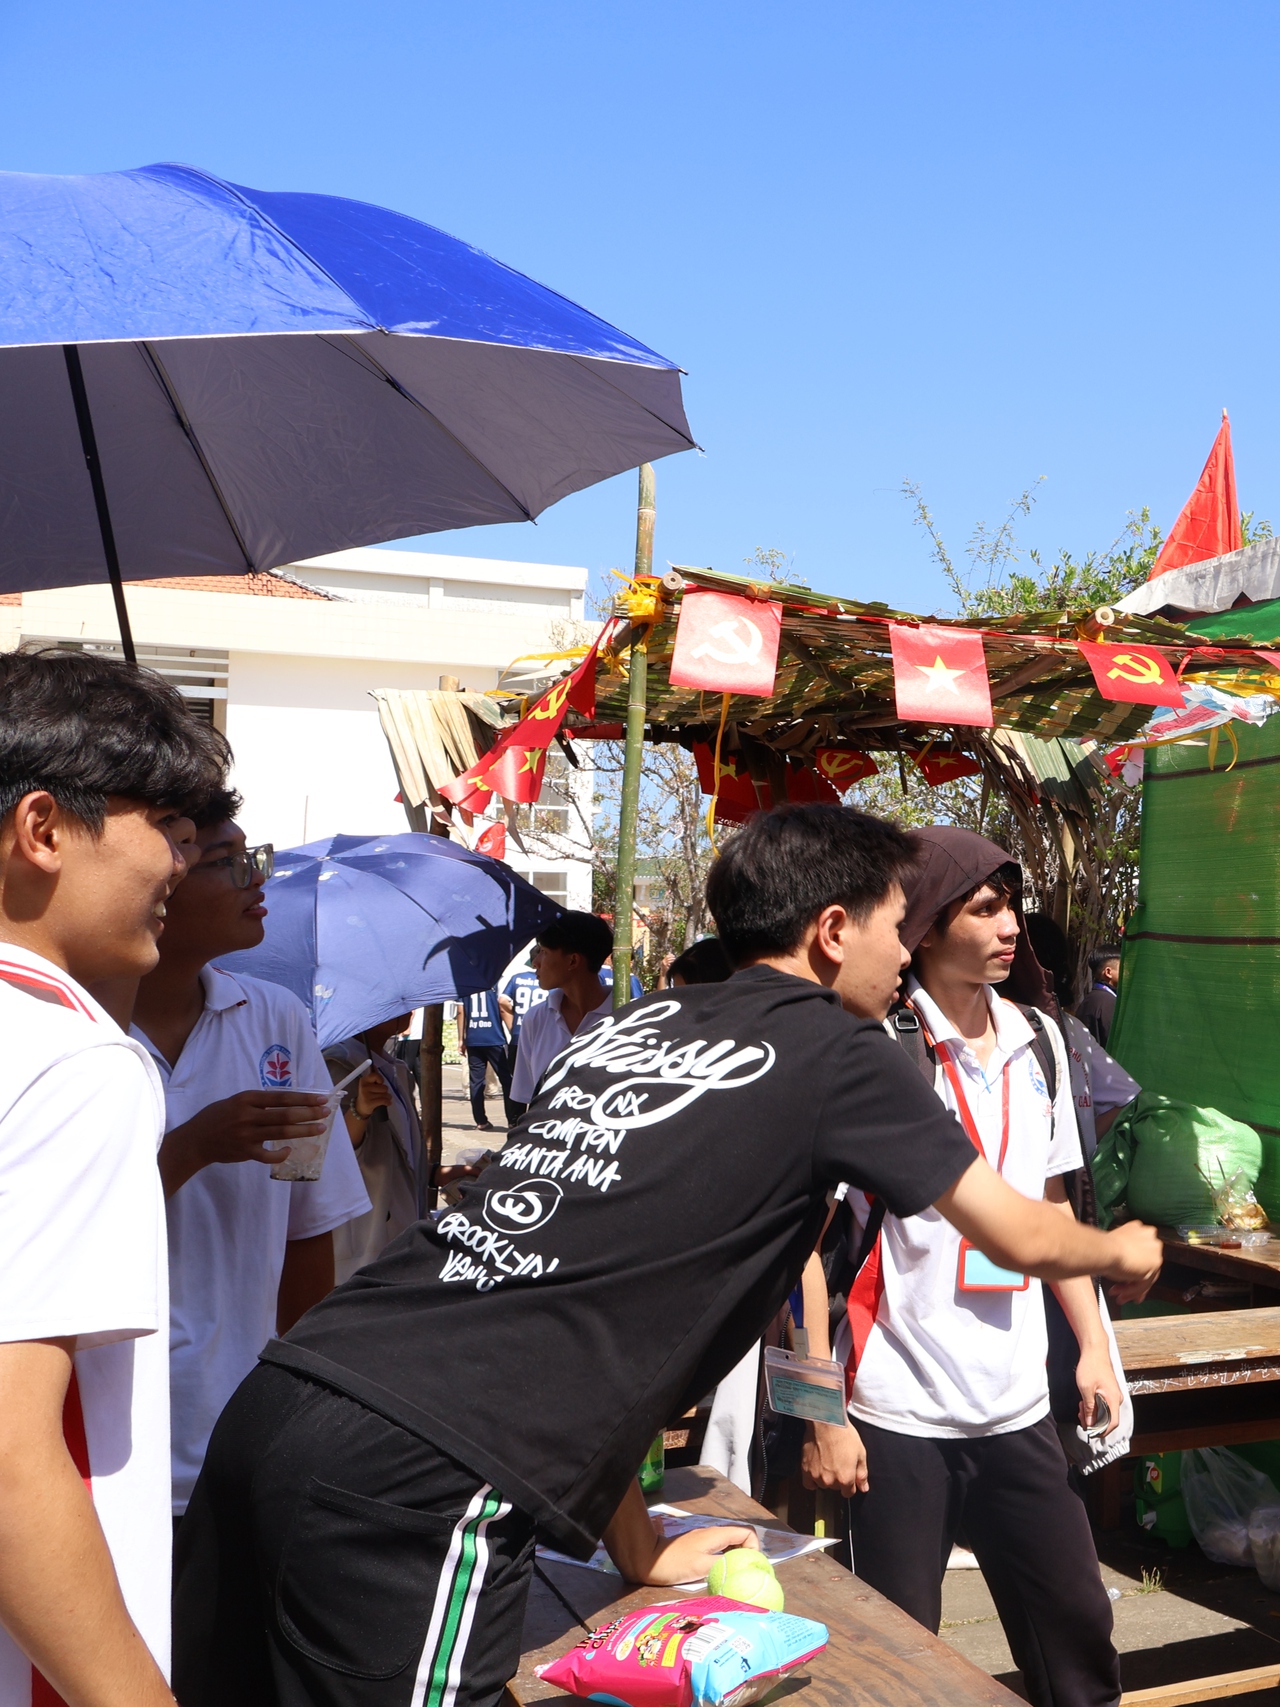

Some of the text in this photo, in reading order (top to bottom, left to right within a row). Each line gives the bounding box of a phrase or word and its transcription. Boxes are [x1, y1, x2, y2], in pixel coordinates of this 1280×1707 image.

[470, 991, 489, 1017] 11
[515, 986, 549, 1014] 98
[478, 1020, 492, 1028] One
[528, 1118, 627, 1155] COMPTON
[499, 1142, 622, 1192] SANTA ANA
